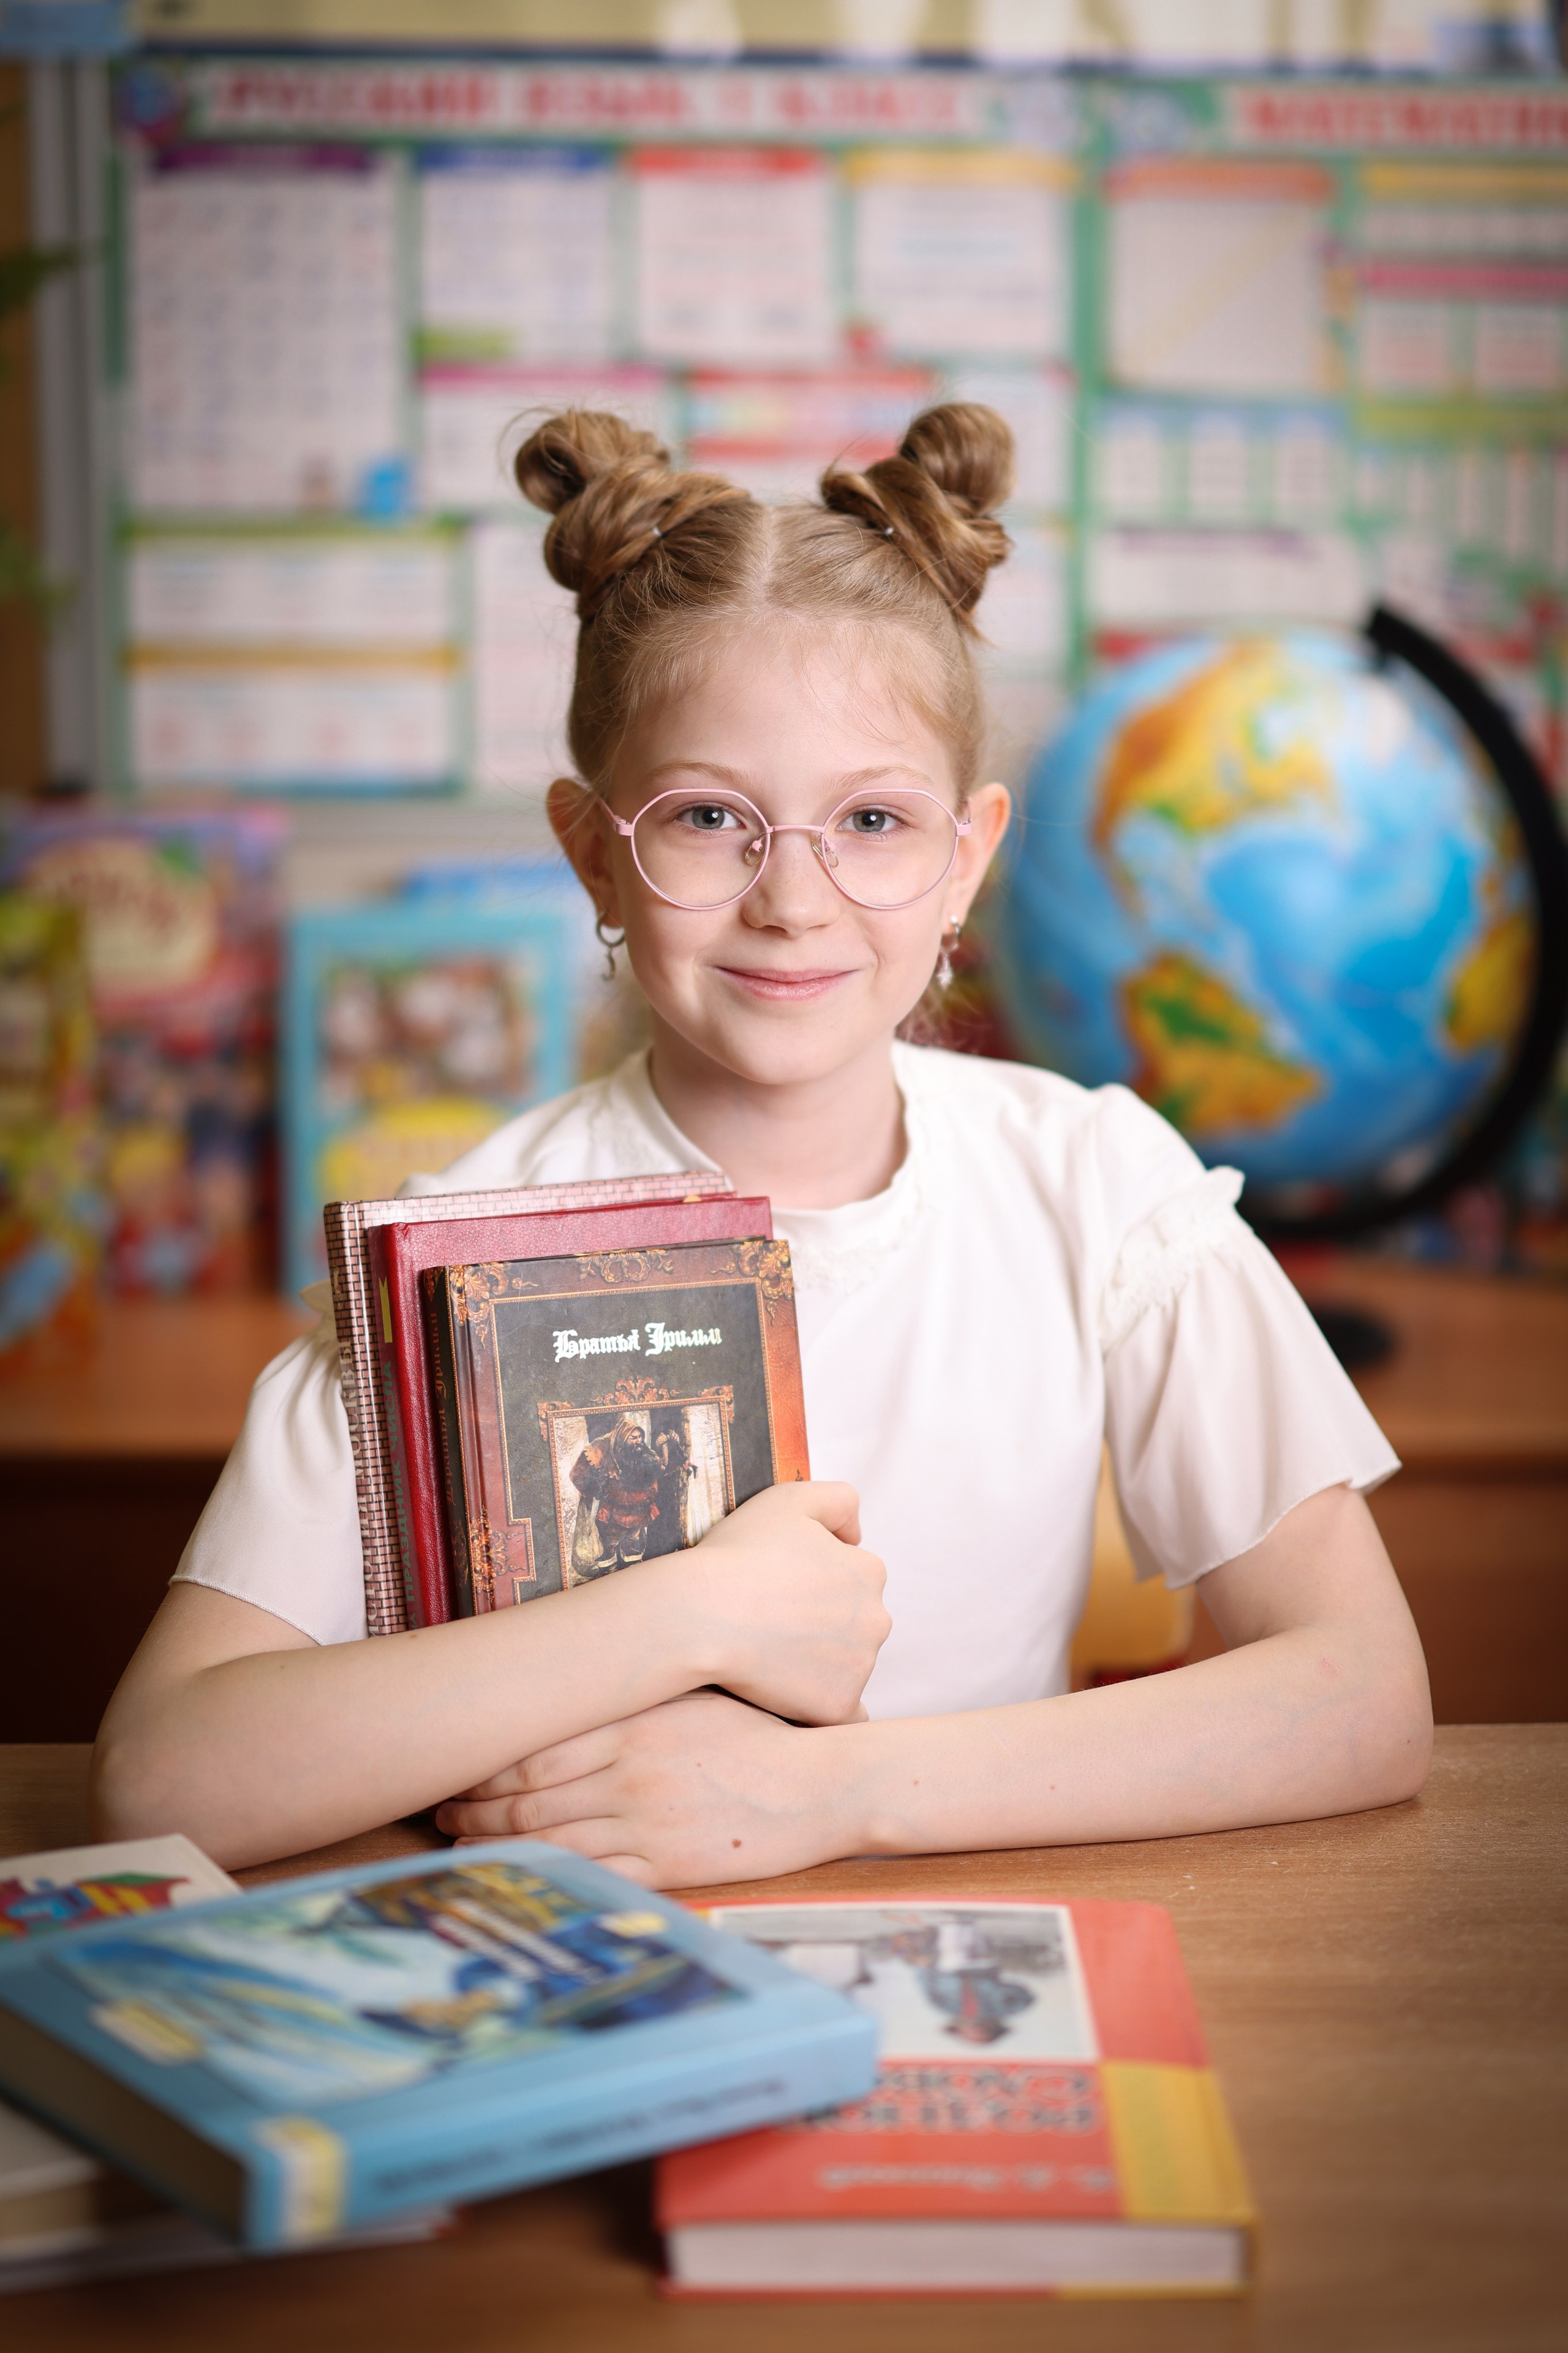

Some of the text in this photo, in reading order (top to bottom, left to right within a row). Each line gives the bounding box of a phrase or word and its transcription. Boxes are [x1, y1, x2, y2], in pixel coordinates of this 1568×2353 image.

[552, 1322, 723, 1363] Братья Гримм
[382, 1361, 398, 1452] ЧИСЛА
[391, 1460, 415, 1603] ПРАЗДНИК
